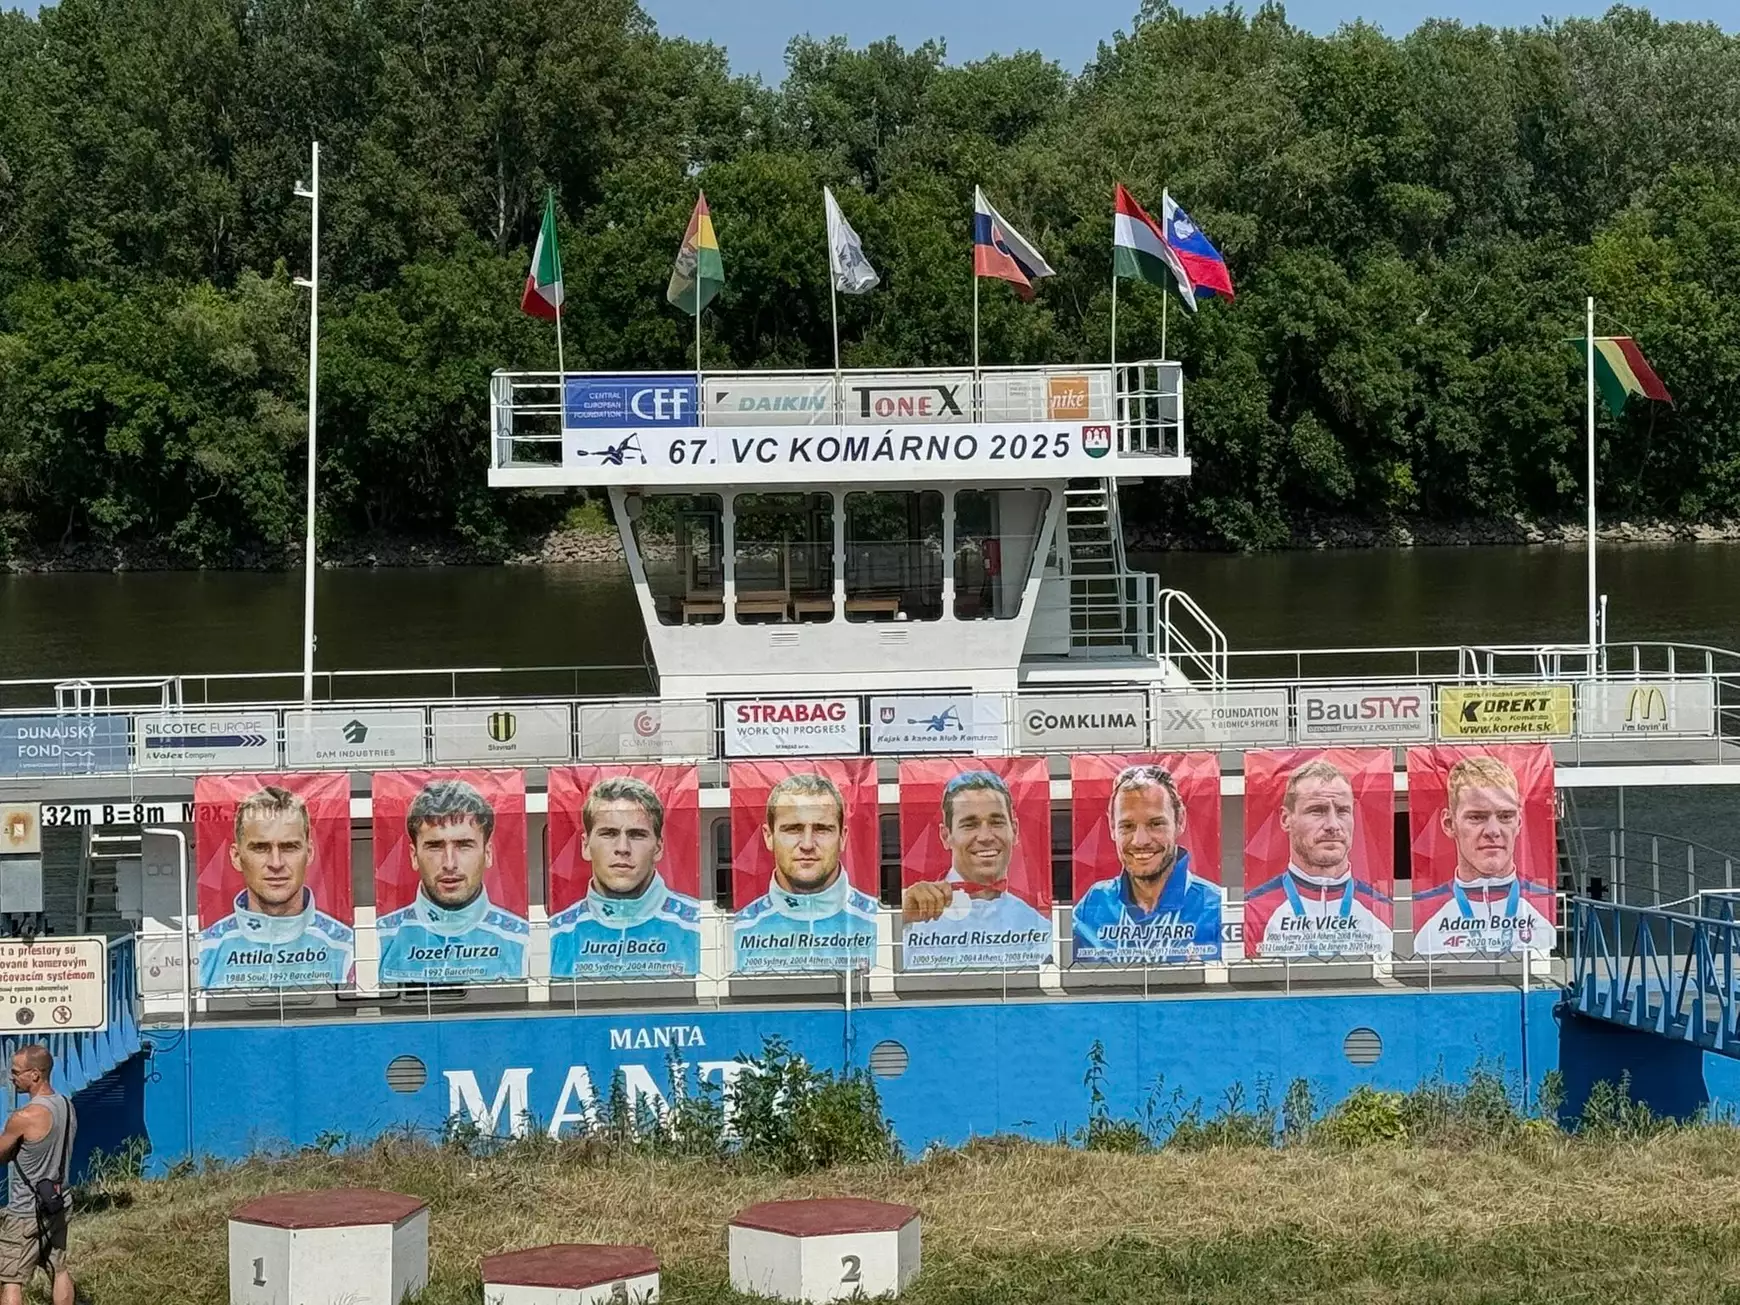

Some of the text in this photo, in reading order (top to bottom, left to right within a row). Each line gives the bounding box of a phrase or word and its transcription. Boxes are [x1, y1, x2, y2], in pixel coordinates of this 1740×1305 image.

[589, 392, 621, 400] CENTRAL
[631, 388, 689, 420] CEF
[739, 396, 826, 411] DAIKIN
[1051, 389, 1085, 409] niké
[584, 401, 621, 409] EUROPEAN
[669, 430, 1071, 465] 67. VC KOMÁRNO 2025
[737, 702, 847, 723] STRABAG
[1211, 706, 1279, 719] FOUNDATION
[1307, 695, 1421, 721] BauSTYR
[1460, 698, 1551, 722] KOREKT
[145, 721, 262, 735] SILCOTEC EUROPE
[1026, 712, 1137, 731] COMKLIMA
[1460, 721, 1552, 734] www.korekt.sk
[1662, 722, 1669, 731] it
[17, 723, 97, 740] DUNAJSKÝ
[737, 724, 847, 737] WORK ON PROGRESS
[877, 734, 900, 743] Kajak
[903, 734, 909, 742] &
[939, 733, 958, 742] klub
[18, 744, 62, 757] FOND
[315, 748, 397, 760] SAM INDUSTRIES
[103, 804, 164, 824] B=8m
[182, 803, 229, 823] Max.
[1280, 914, 1359, 931] Erik Vlček
[1439, 914, 1535, 932] Adam Botek
[740, 932, 872, 949] Michal Riszdorfer
[908, 929, 1050, 947] Richard Riszdorfer
[1100, 924, 1195, 940] JURAJ TARR
[8, 948, 14, 956] a
[18, 946, 61, 957] priestory
[64, 945, 76, 955] sú
[581, 939, 666, 957] Juraj Bača
[1466, 938, 1487, 947] 2020
[1488, 937, 1512, 948] Tokyo
[226, 947, 327, 965] Attila Szabó
[407, 945, 500, 960] Jozef Turza
[32, 957, 87, 969] kamerovým
[423, 968, 443, 977] 1992
[610, 1024, 706, 1050] MANTA
[443, 1058, 808, 1145] MANT
[252, 1257, 267, 1287] 1
[841, 1254, 861, 1282] 2
